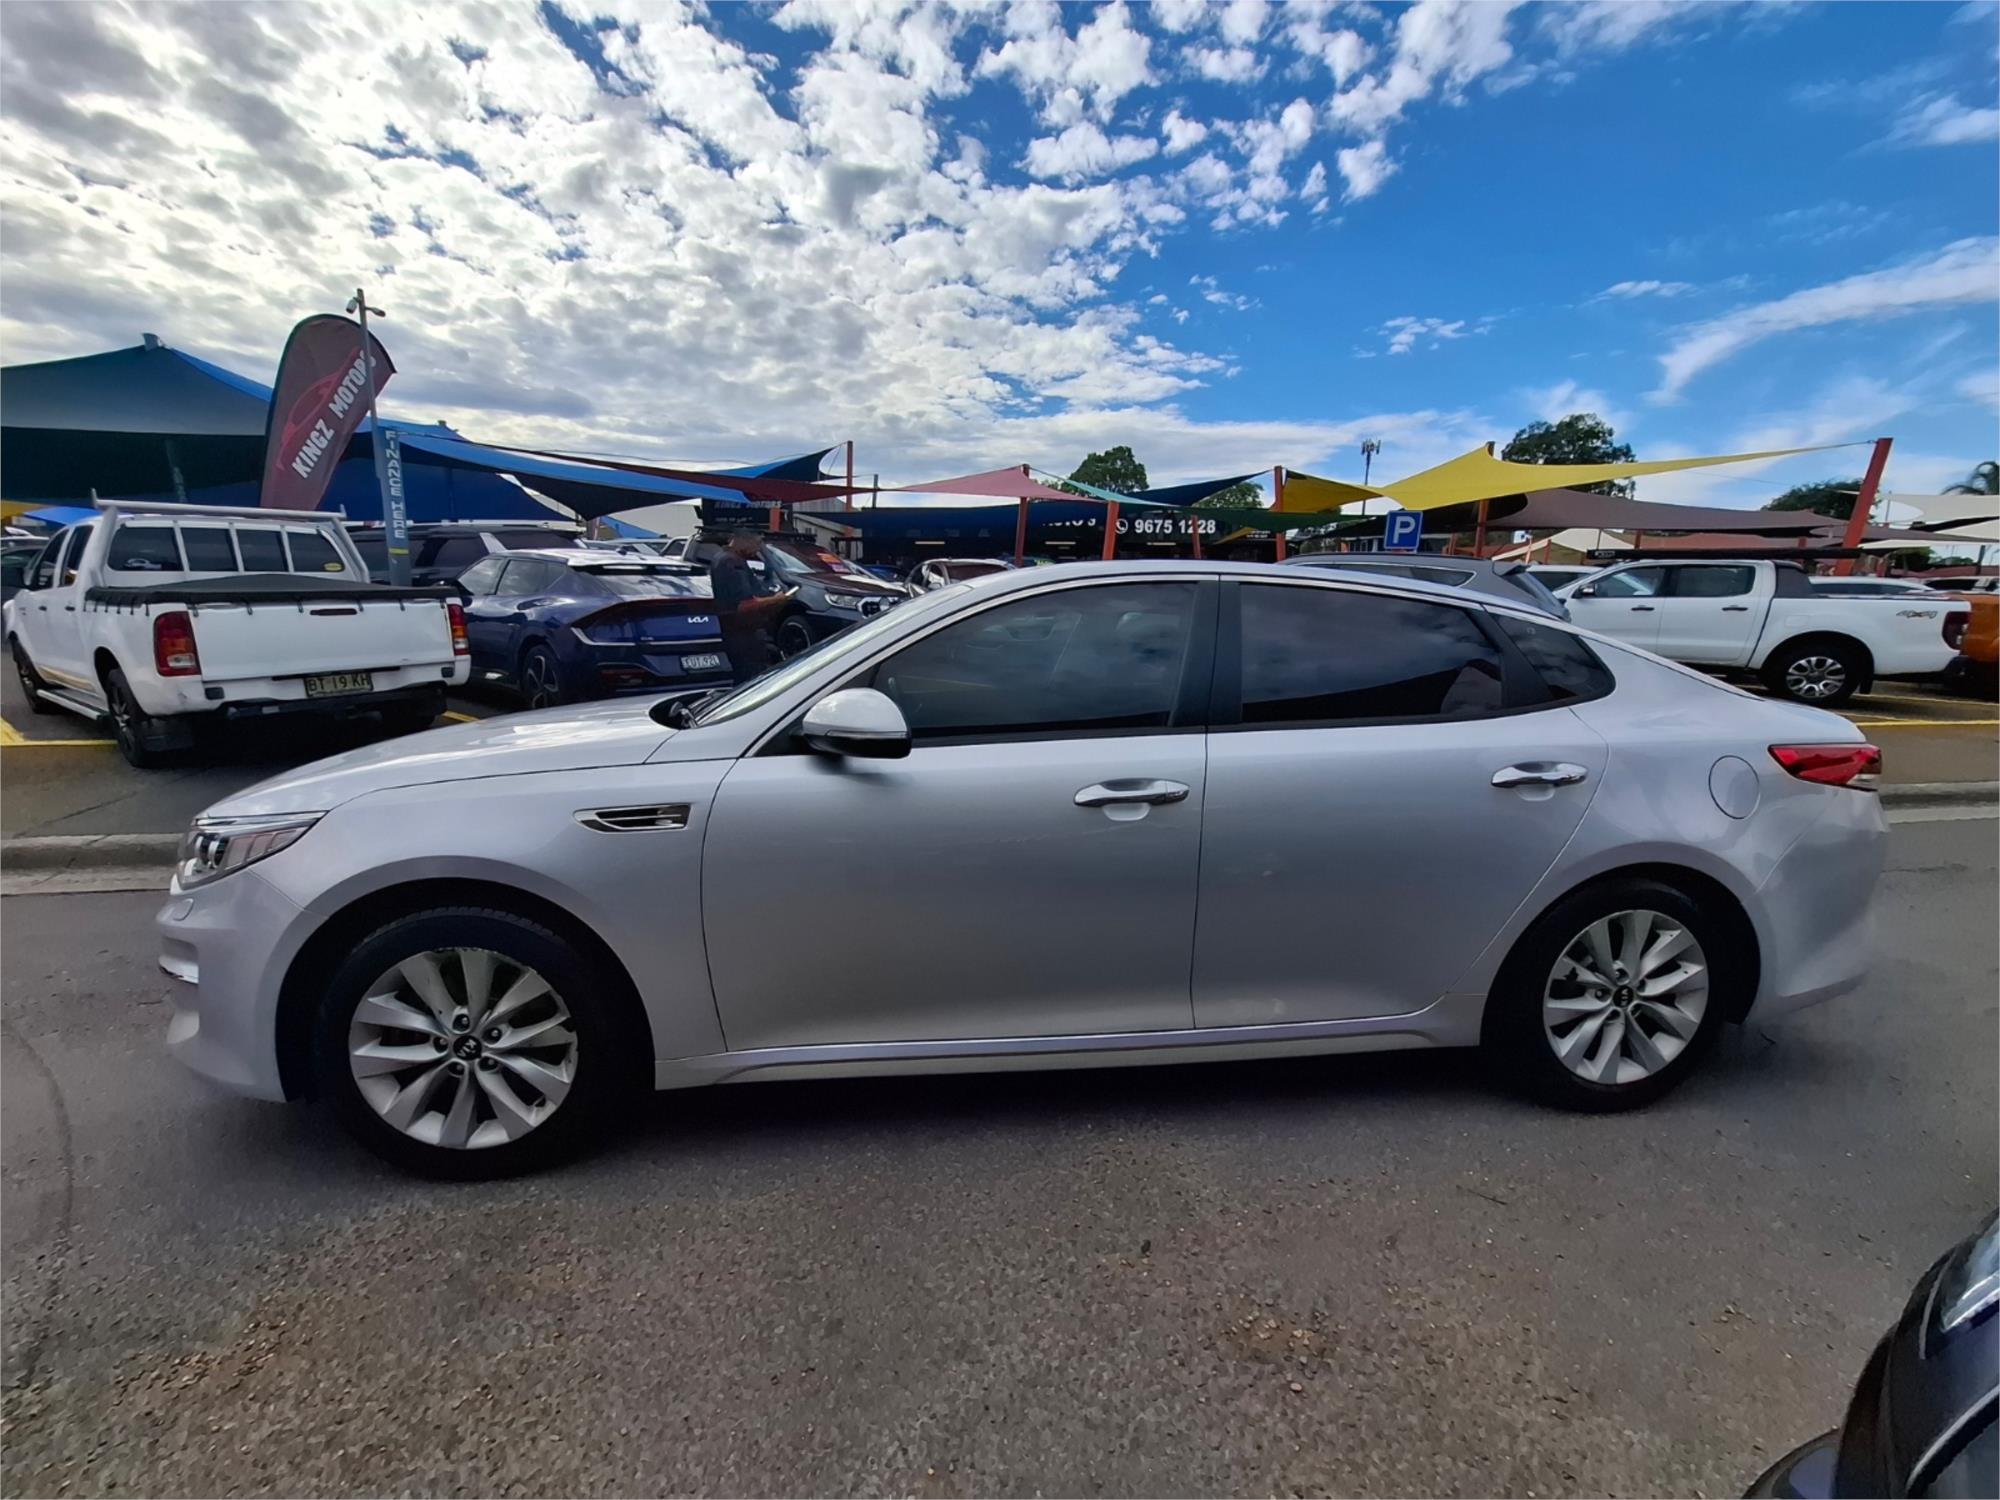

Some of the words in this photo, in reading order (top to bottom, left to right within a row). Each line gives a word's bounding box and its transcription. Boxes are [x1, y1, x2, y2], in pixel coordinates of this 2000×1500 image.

[292, 418, 335, 478] KINGZ
[385, 430, 401, 496] FINANCE
[391, 500, 405, 538] HERE
[1134, 519, 1173, 534] 9675
[1178, 519, 1216, 534] 1228
[1393, 515, 1416, 544] P
[457, 1039, 477, 1057] KIA
